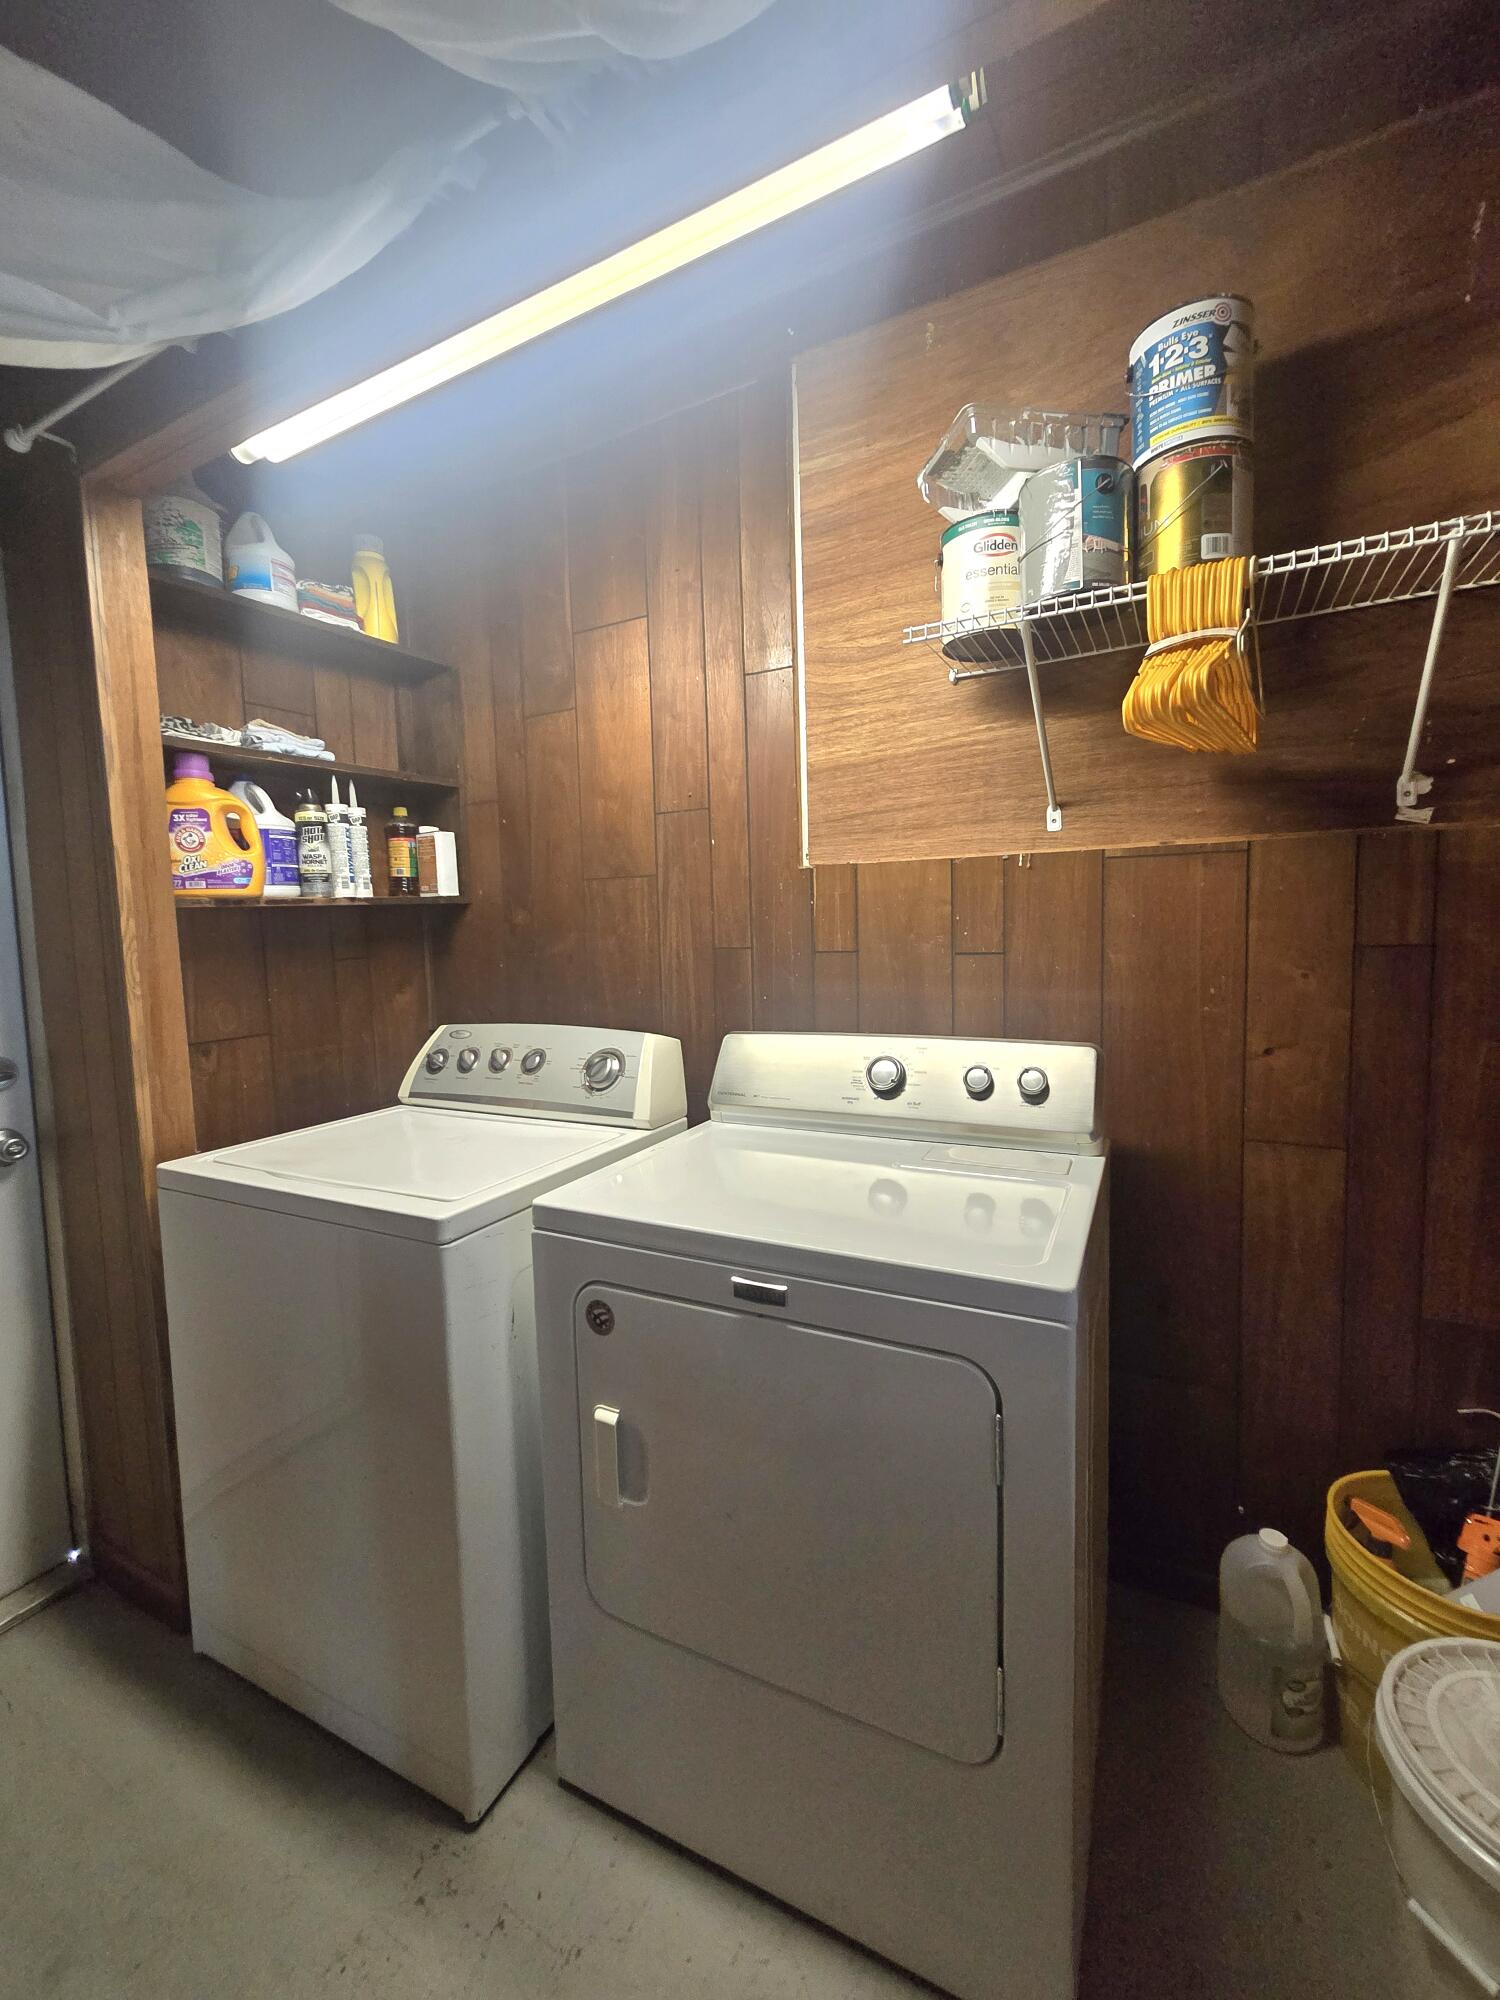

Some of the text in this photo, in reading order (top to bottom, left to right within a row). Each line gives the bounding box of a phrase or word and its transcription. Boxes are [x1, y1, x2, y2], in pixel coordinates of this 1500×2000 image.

[1172, 309, 1216, 329] ZINSSER
[1158, 330, 1199, 352] Bulls Eye
[1149, 364, 1217, 401] PRIMER
[973, 539, 1018, 553] Glidden
[172, 814, 186, 822] 3X
[303, 826, 322, 836] HOT
[302, 833, 325, 844] SHOT
[183, 855, 200, 864] OXI
[179, 860, 208, 873] CLEAN
